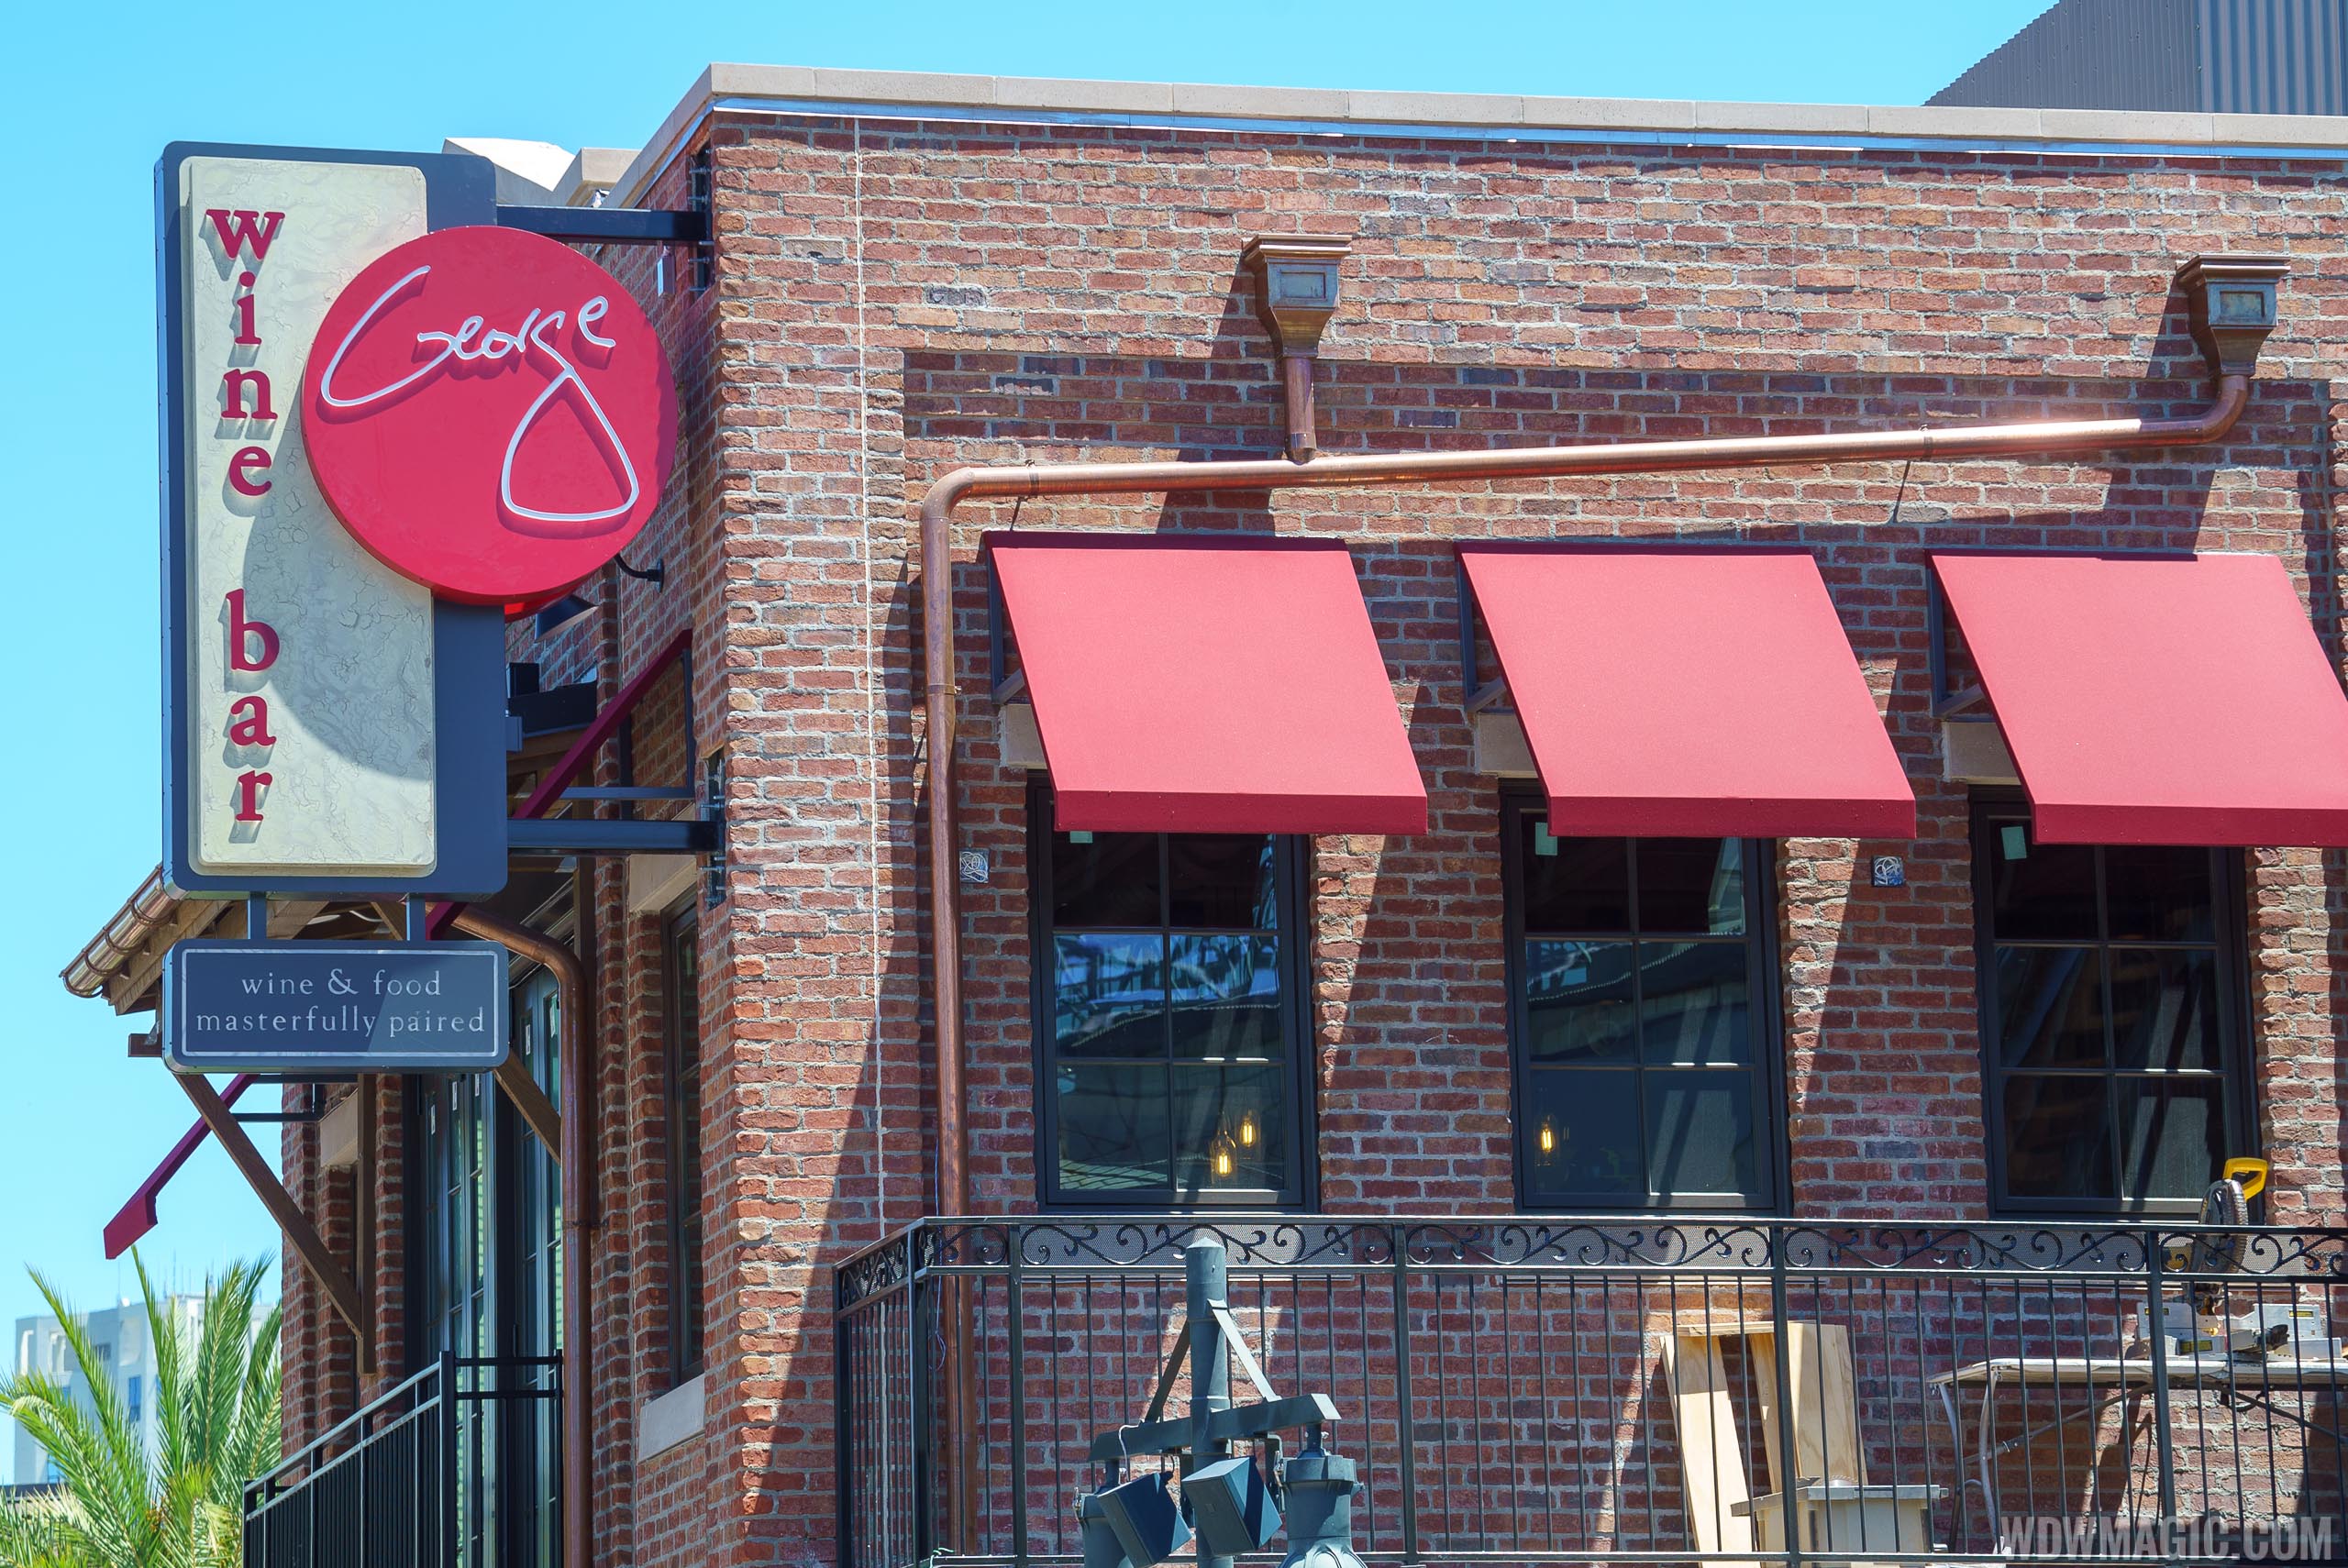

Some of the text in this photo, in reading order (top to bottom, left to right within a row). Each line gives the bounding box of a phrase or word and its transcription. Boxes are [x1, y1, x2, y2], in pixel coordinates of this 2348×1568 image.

[320, 265, 640, 523] George
[205, 209, 285, 822] wine bar
[195, 1005, 485, 1038] masterfully paired
[241, 968, 441, 997] wine & food
